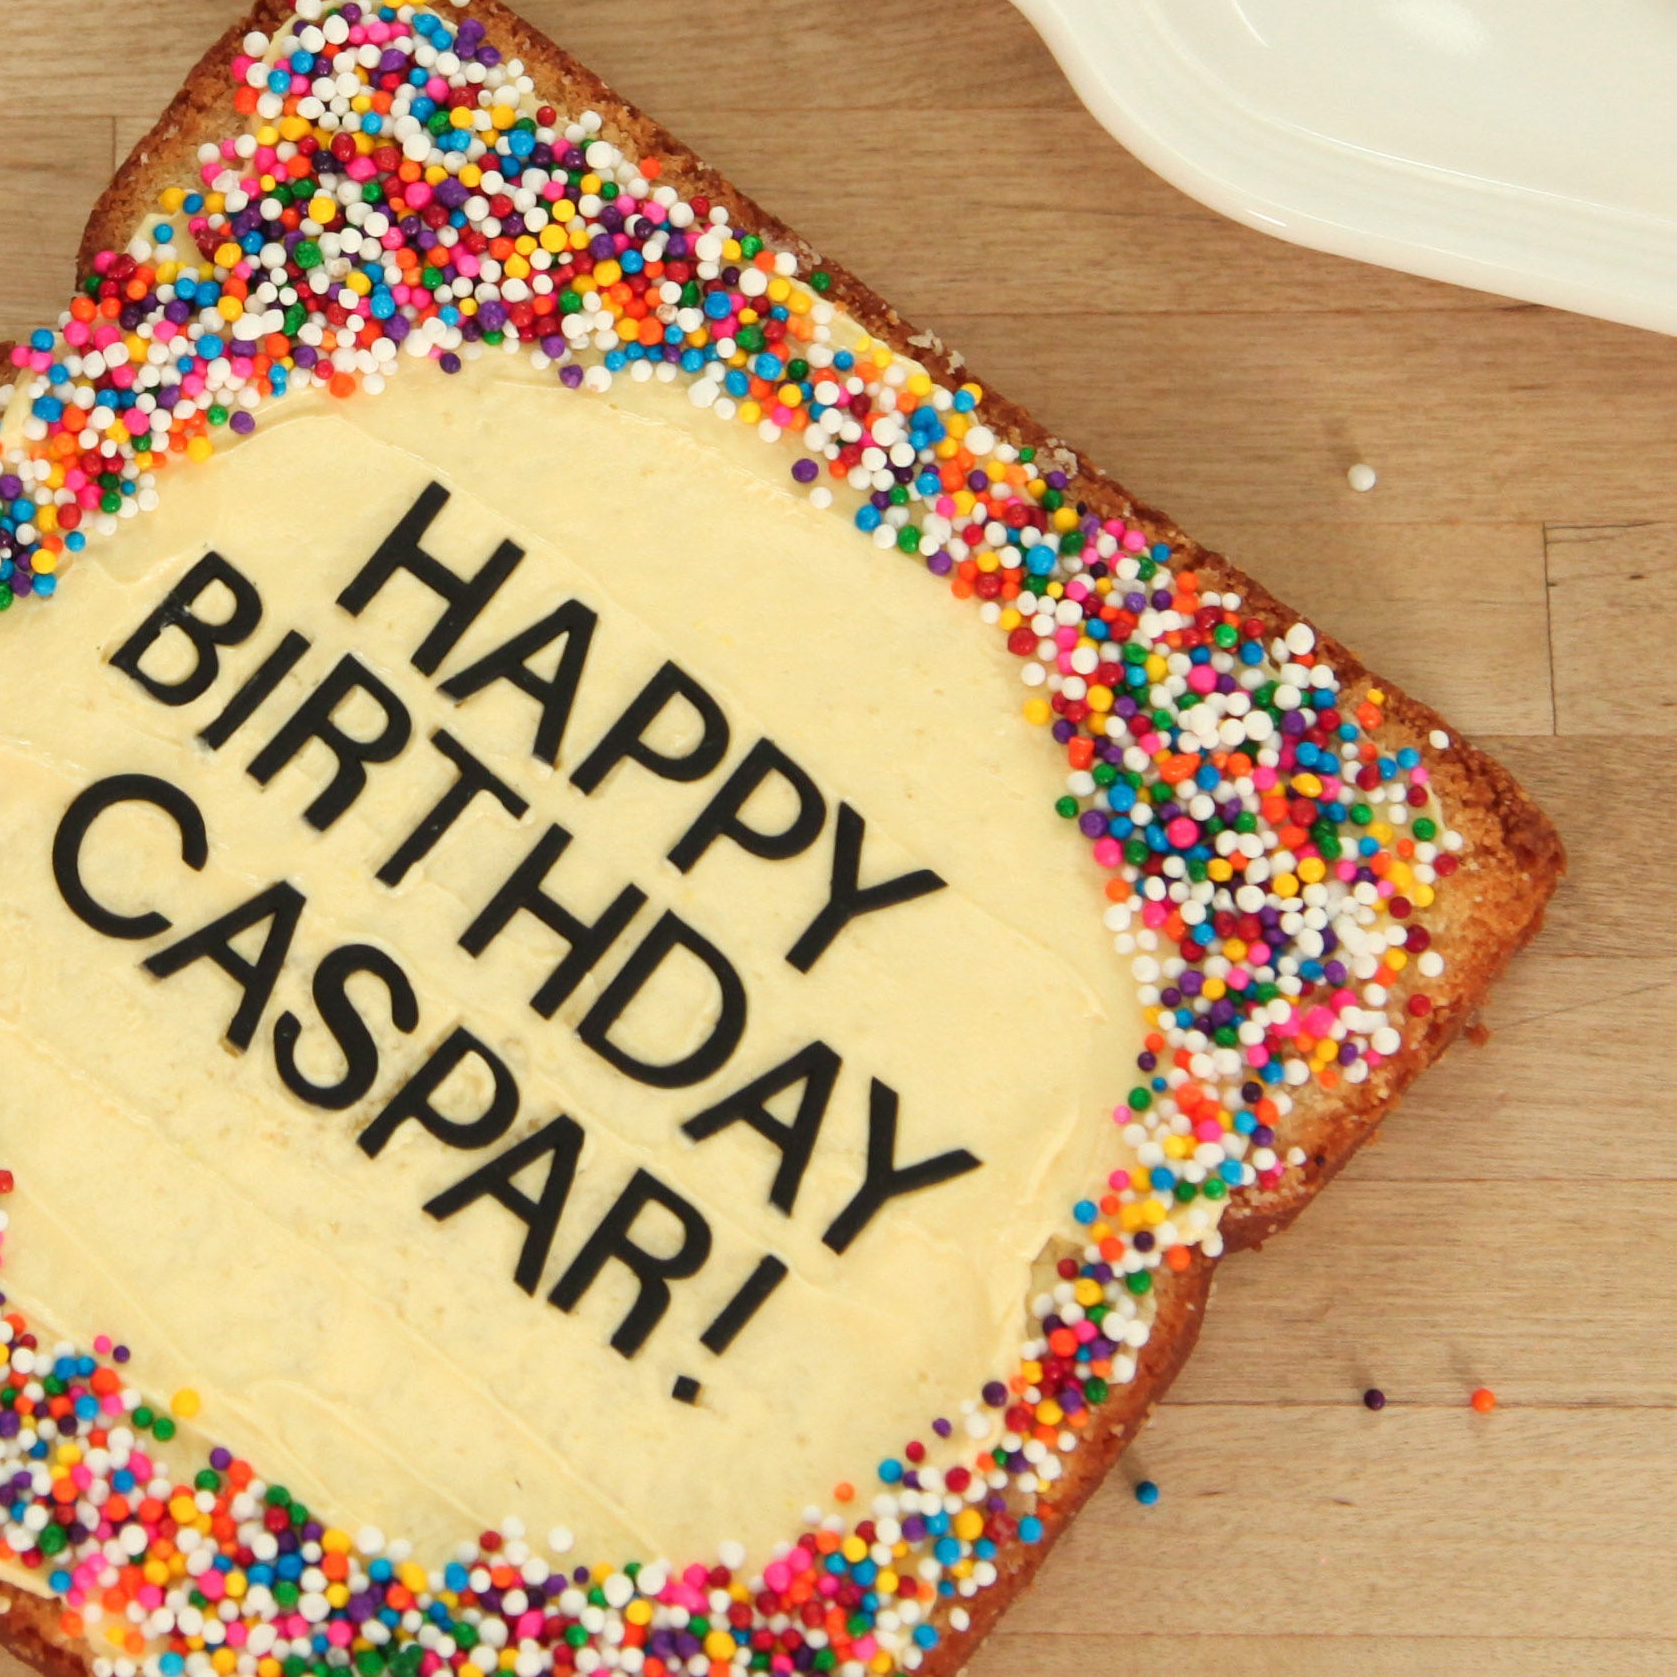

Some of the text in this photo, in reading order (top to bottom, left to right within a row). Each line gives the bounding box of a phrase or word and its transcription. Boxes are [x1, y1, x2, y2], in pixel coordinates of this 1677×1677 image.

[108, 551, 982, 1256] BIRTHDAY
[336, 480, 948, 974] HAPPY
[51, 773, 788, 1405] CASPAR!
